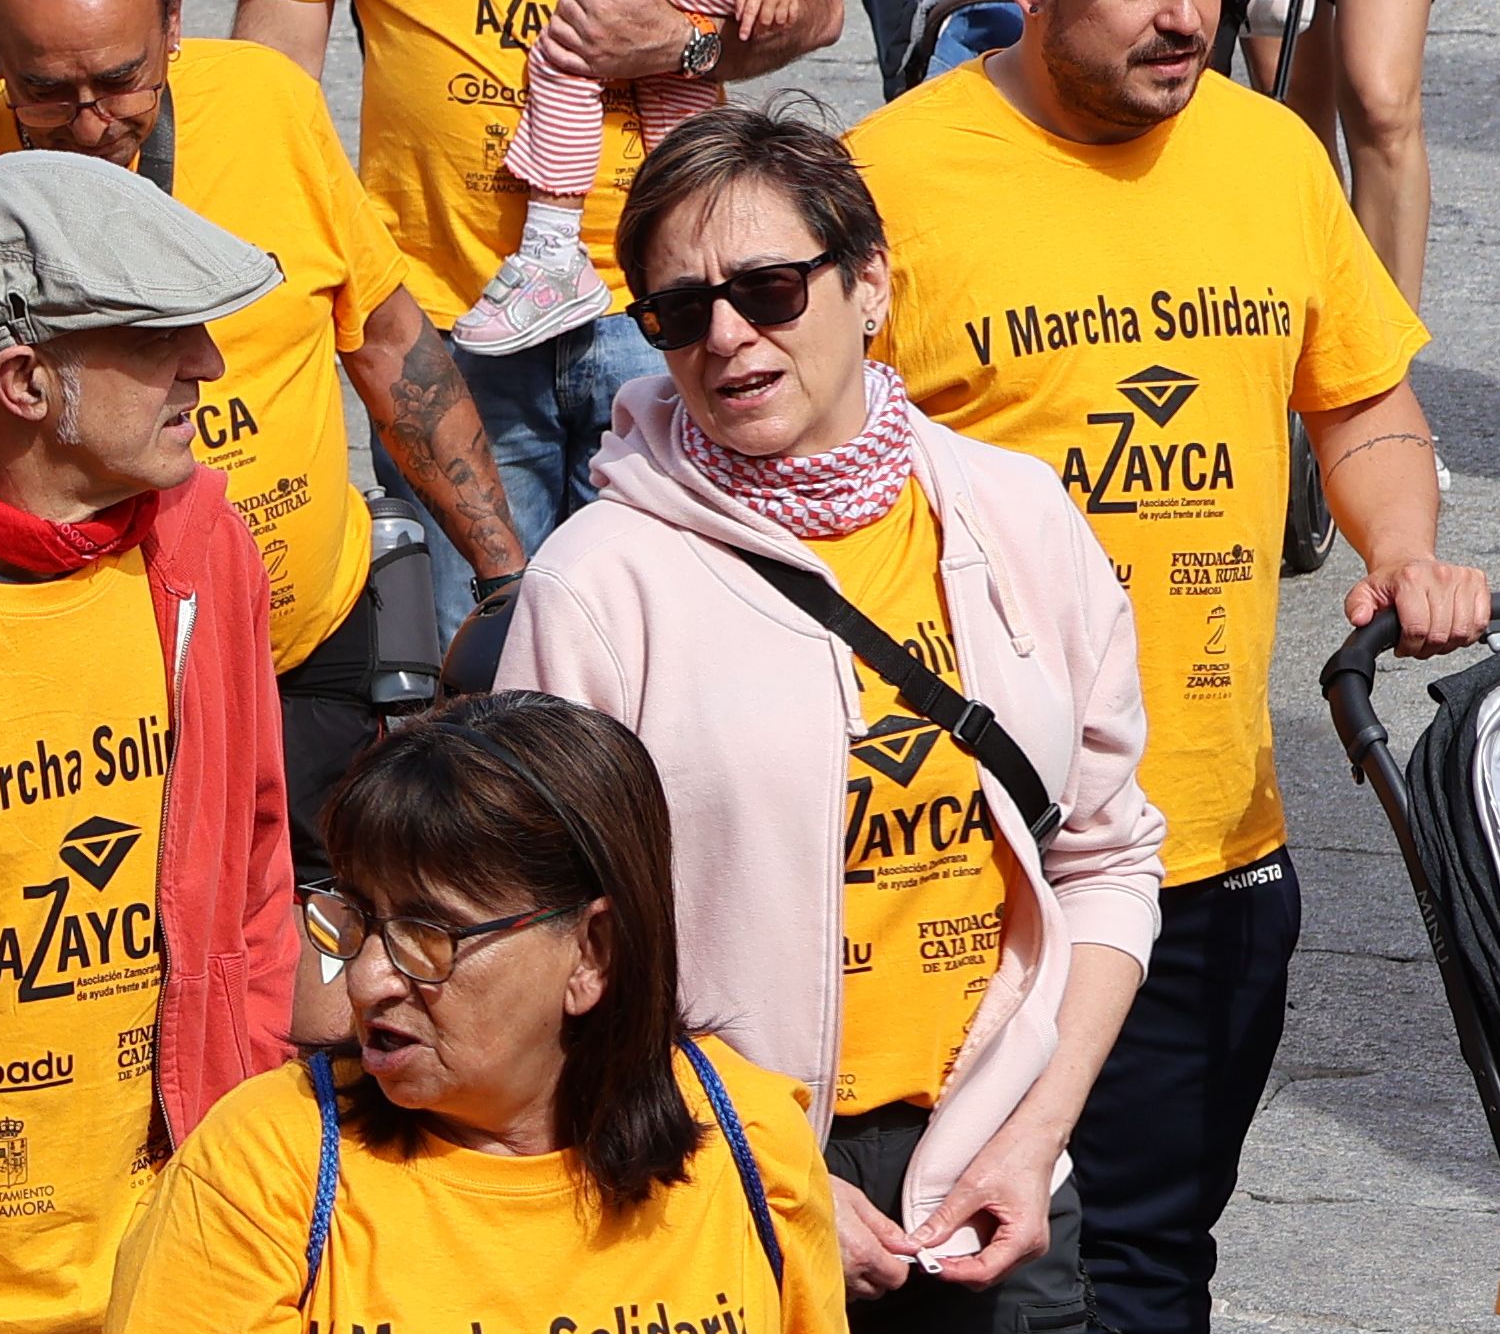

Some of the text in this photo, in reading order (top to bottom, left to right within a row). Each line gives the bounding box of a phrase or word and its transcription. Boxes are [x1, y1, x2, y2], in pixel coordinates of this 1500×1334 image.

[965, 286, 1292, 366] V Marcha Solidaria
[1063, 412, 1236, 513] AZAYCA
[1169, 563, 1253, 587] CAJA RURAL
[1169, 586, 1183, 596] DE
